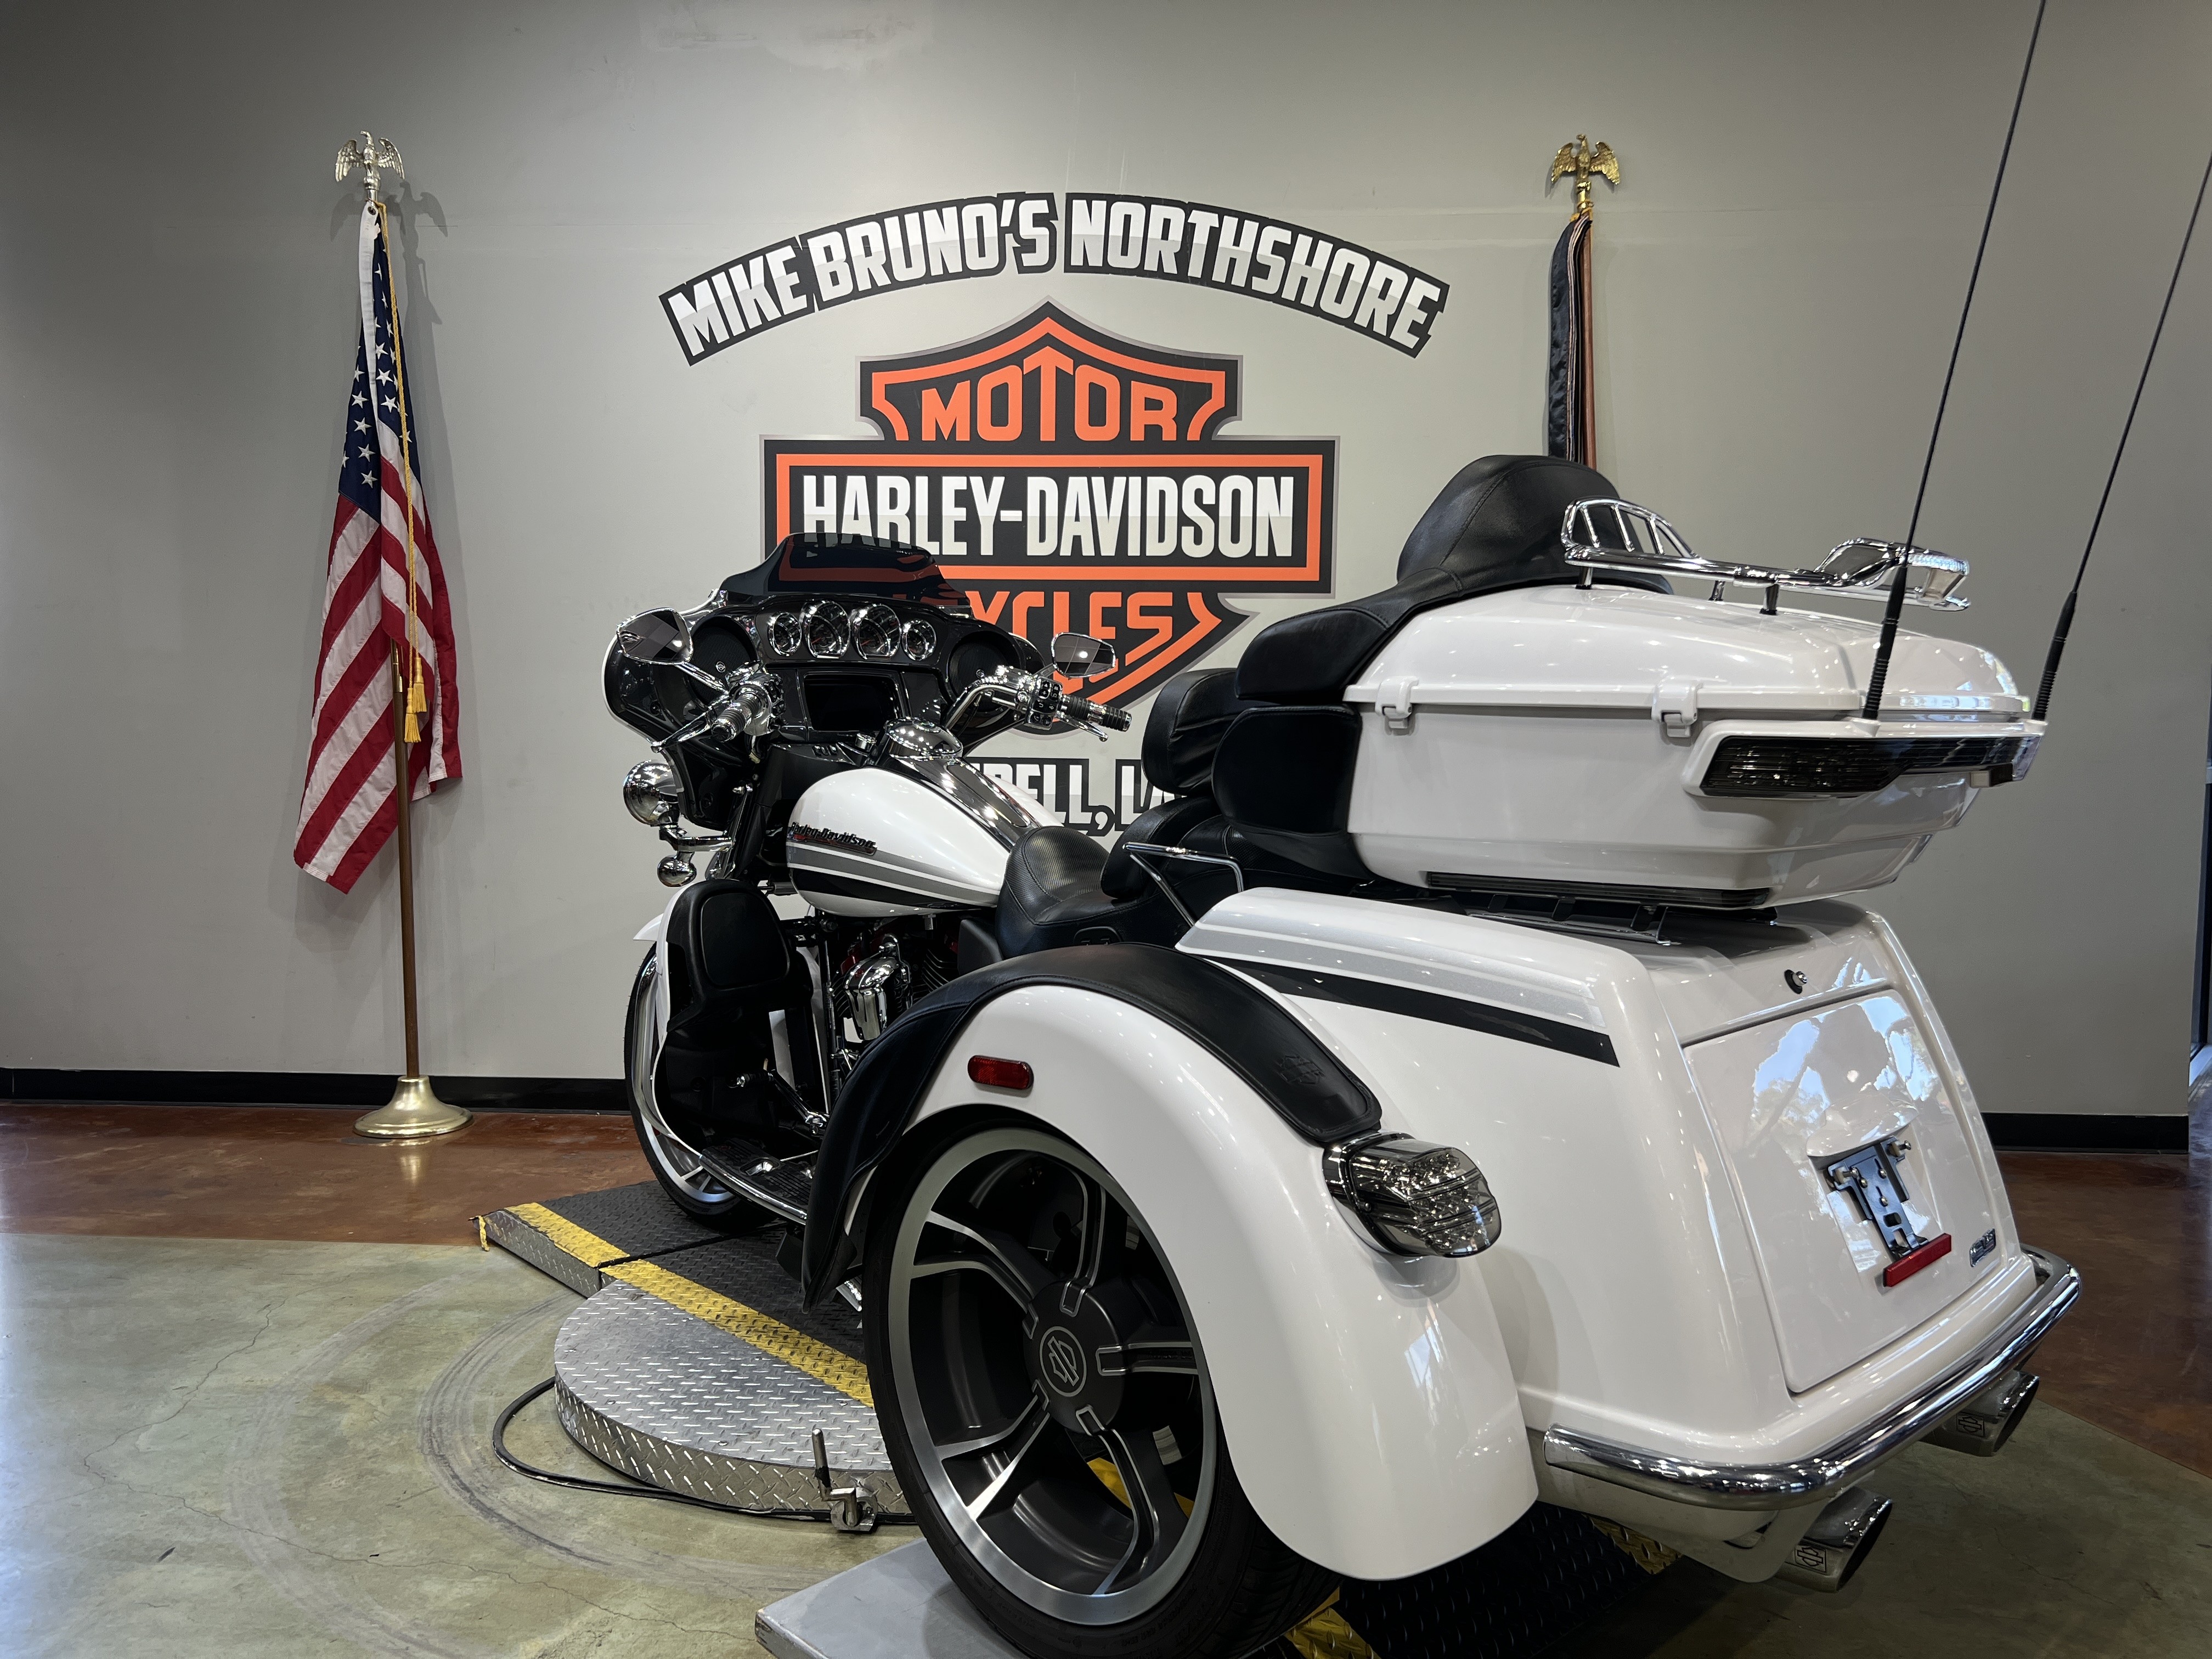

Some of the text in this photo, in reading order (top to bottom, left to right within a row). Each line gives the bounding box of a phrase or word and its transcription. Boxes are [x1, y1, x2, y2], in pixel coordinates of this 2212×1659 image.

[668, 199, 1442, 357] MIKE BRUNO'S NORTHSHORE
[922, 345, 1178, 442] MOTOR
[803, 475, 1294, 558] HARLEY-DAVIDSON
